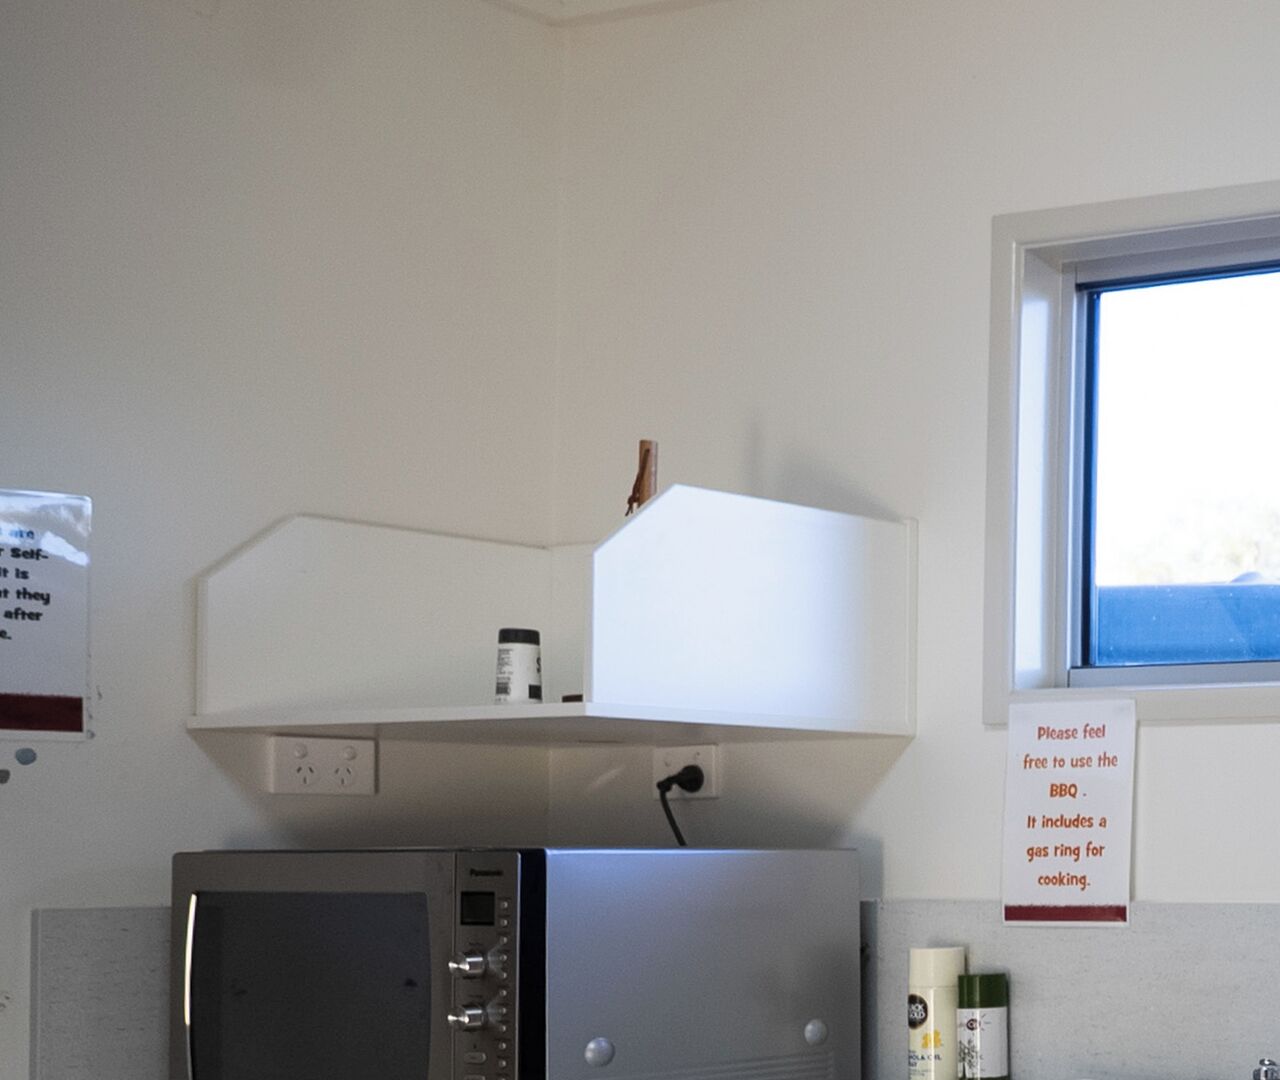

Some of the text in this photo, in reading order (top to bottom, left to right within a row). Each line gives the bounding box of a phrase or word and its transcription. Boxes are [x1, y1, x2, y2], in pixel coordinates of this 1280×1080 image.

[10, 547, 49, 561] Self-
[15, 567, 29, 580] is
[15, 587, 51, 606] they
[3, 607, 43, 621] after
[1037, 723, 1106, 740] Please feel
[1023, 751, 1118, 770] free to use the
[1050, 783, 1078, 799] BBQ
[1027, 813, 1107, 829] It includes a
[1027, 841, 1105, 862] gas ring for
[1038, 871, 1091, 891] cooking.
